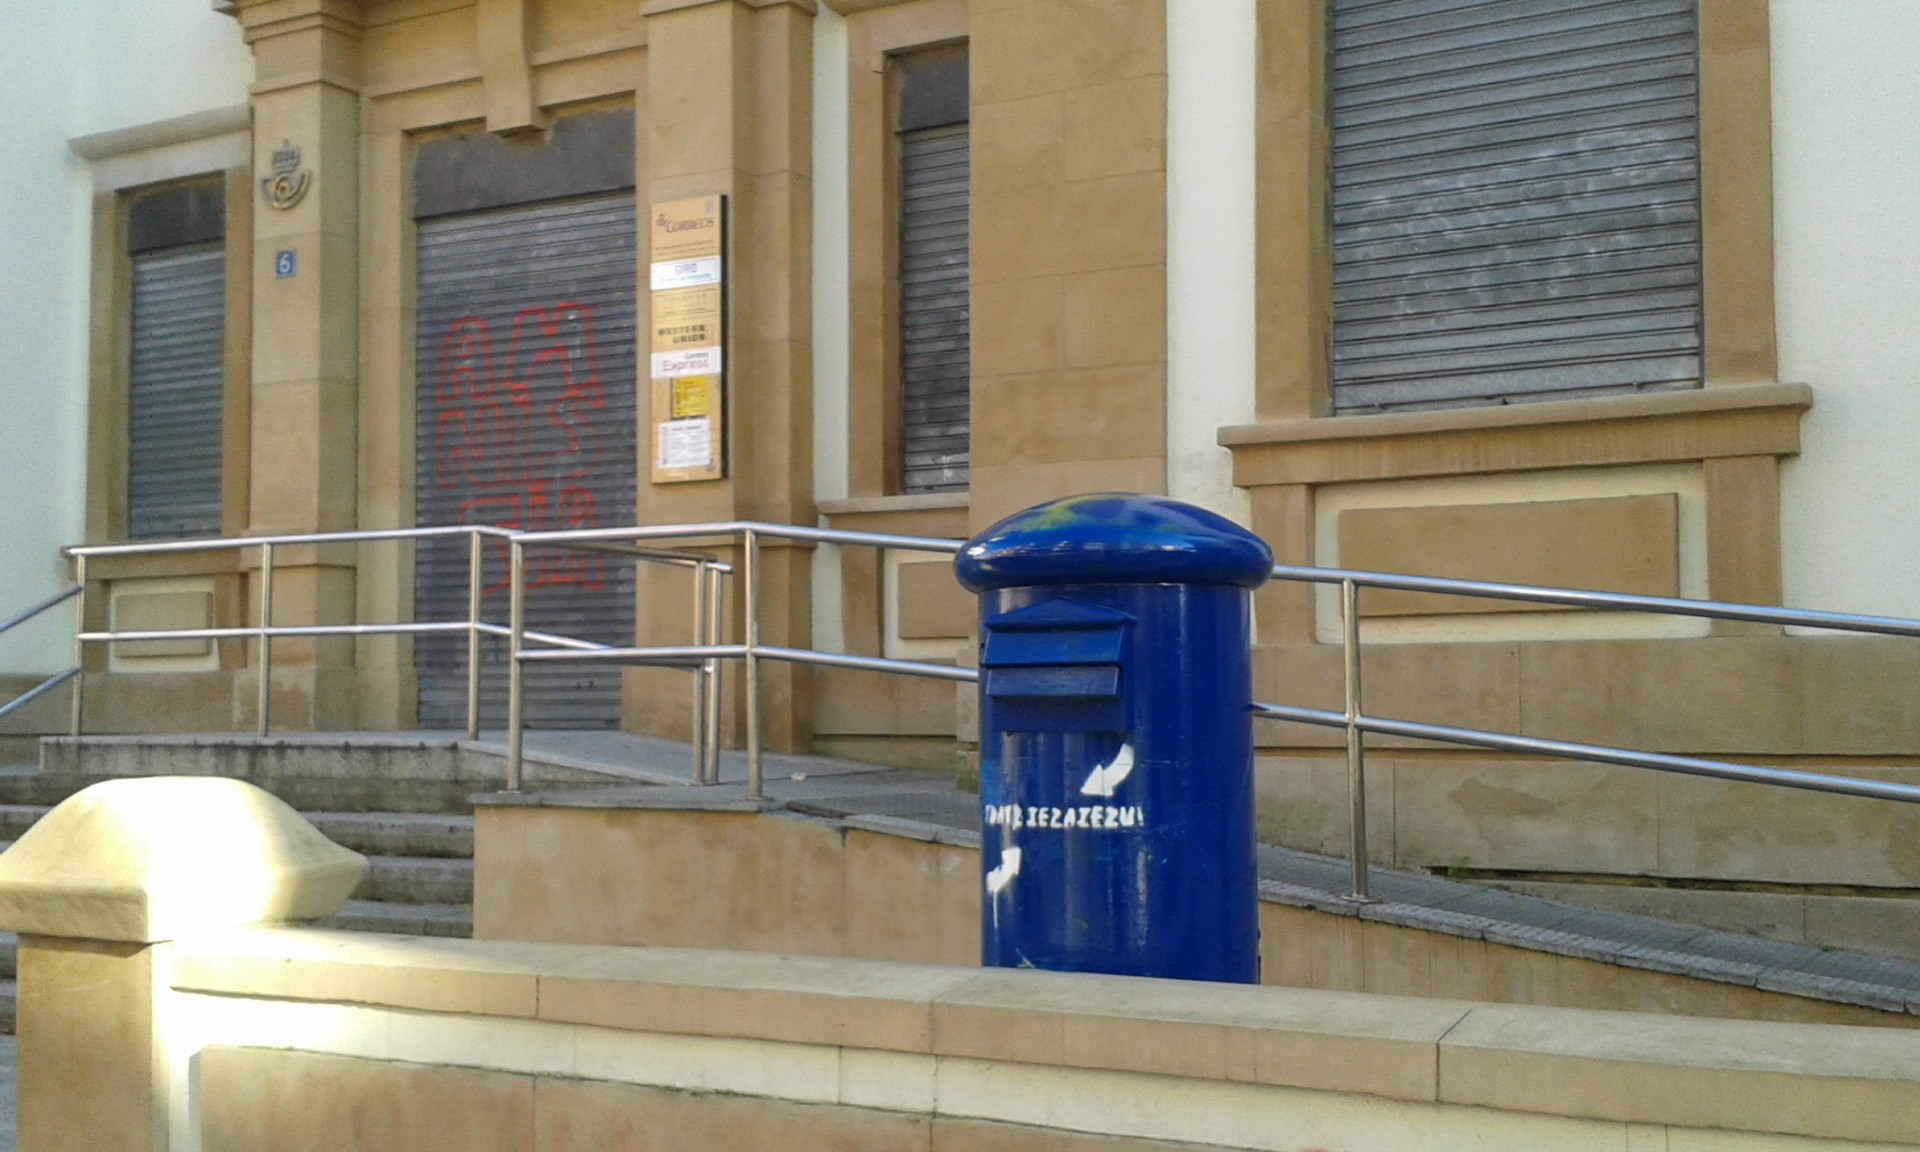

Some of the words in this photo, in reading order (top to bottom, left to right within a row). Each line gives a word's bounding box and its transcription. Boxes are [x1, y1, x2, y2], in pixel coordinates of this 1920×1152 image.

[279, 253, 290, 273] 6
[658, 324, 706, 336] WESTERN
[672, 333, 706, 344] UNION
[662, 358, 710, 372] Express
